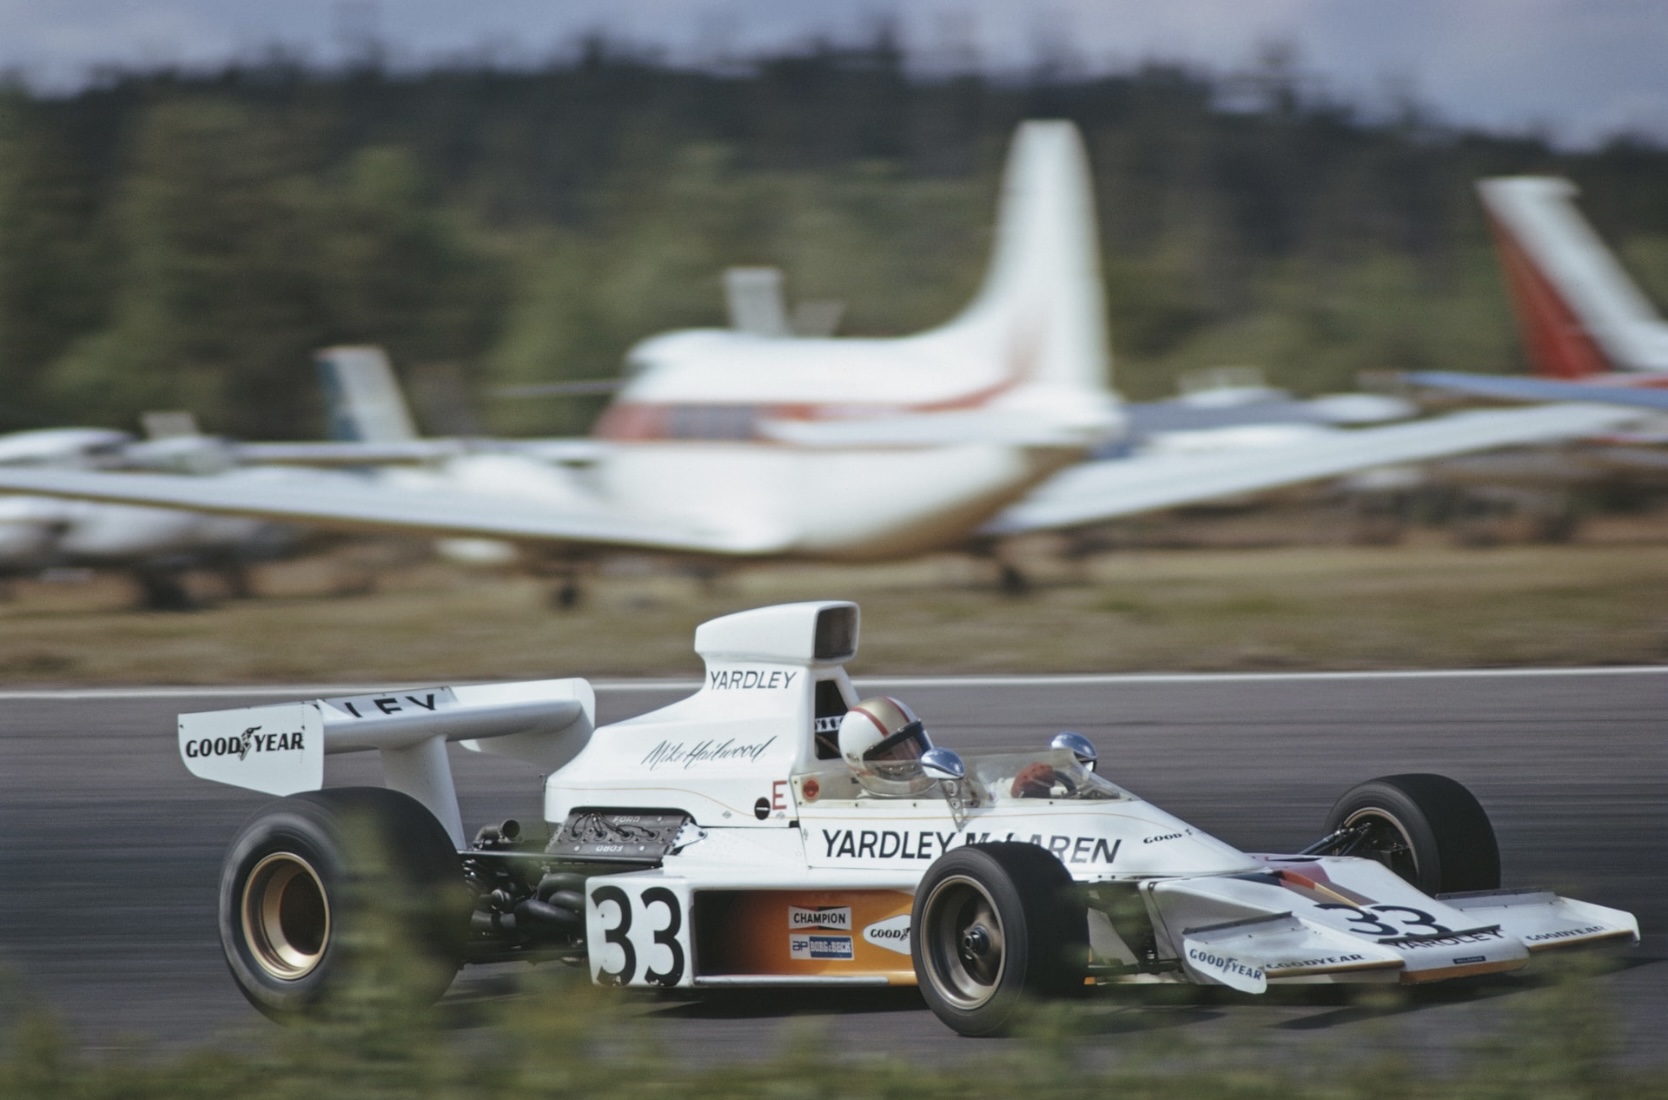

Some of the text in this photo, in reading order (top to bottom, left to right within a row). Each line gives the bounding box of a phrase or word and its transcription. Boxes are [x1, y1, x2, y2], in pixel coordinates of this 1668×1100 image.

[709, 671, 797, 690] YARDLEY
[641, 735, 778, 771] Mike Hailwood
[771, 780, 788, 811] E
[612, 815, 641, 823] FORD
[595, 844, 624, 852] FORD
[822, 829, 957, 859] YARDLEY
[793, 912, 847, 925] CHAMPION
[1313, 903, 1453, 937] 33
[590, 885, 685, 987] 33
[1266, 952, 1366, 970] GOODYEAR
